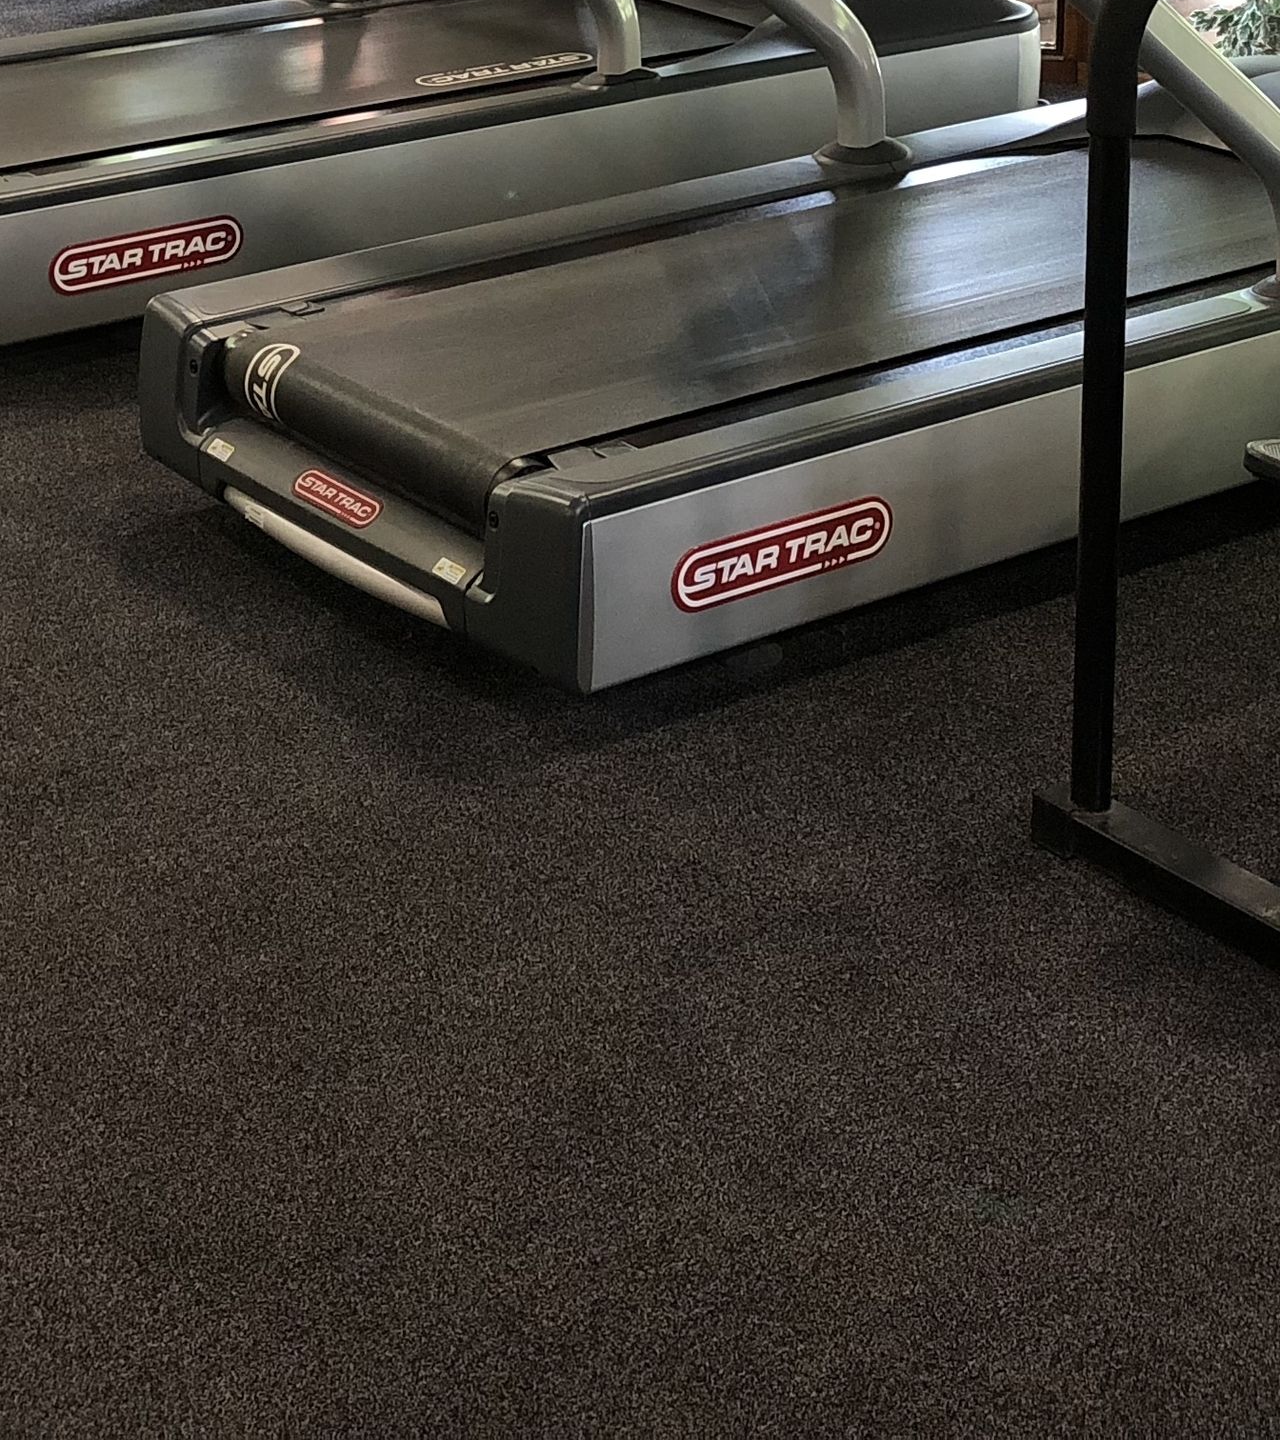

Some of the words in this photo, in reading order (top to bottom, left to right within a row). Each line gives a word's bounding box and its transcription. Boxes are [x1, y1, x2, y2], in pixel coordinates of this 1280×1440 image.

[64, 247, 144, 281] STAR
[148, 231, 227, 264] TRAC
[299, 476, 338, 499] STAR
[333, 492, 372, 518] TRAC
[687, 545, 780, 594] STAR
[785, 517, 874, 563] TRAC
